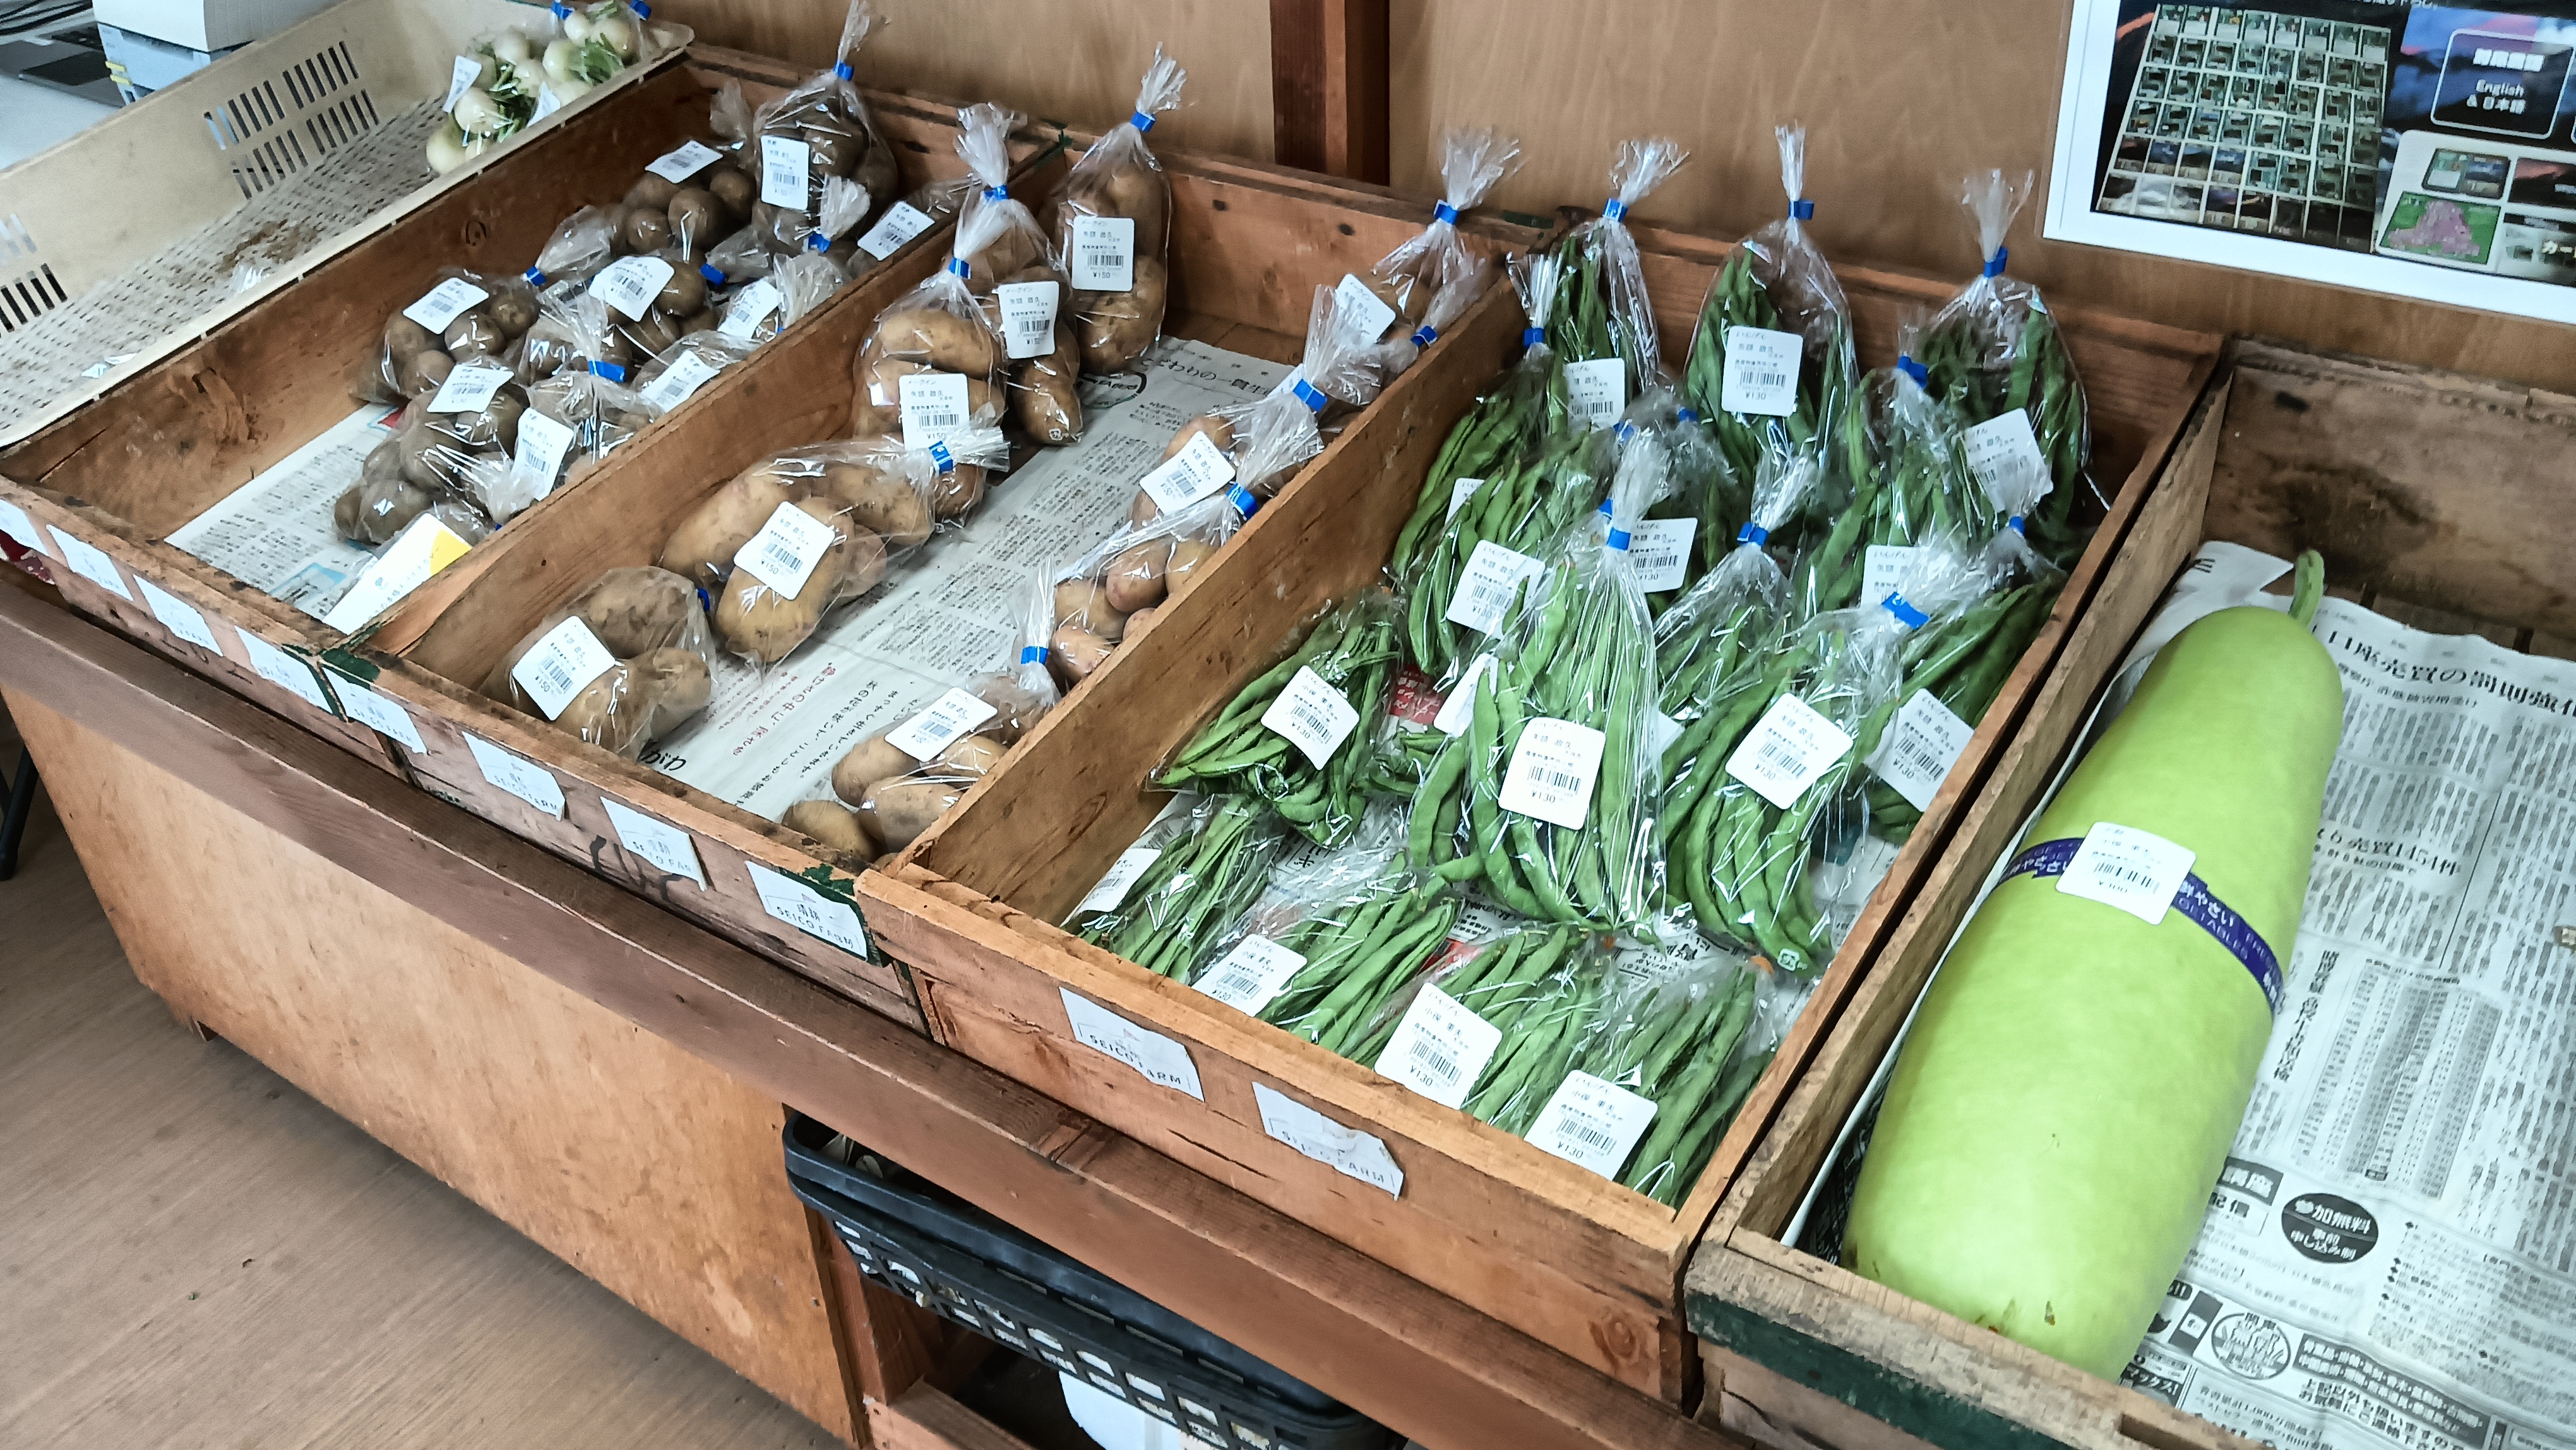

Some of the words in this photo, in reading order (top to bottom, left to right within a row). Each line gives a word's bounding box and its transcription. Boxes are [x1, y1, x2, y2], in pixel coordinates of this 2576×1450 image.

[2476, 79, 2525, 97] English
[760, 558, 779, 575] ¥150
[1291, 721, 1311, 739] ¥130
[1755, 764, 1776, 781] ¥130
[1531, 791, 1556, 804] ¥130
[777, 906, 814, 929] SEICO
[819, 925, 854, 949] FARM
[1089, 1034, 1133, 1062] SEICO
[1138, 1061, 1182, 1085] FARM
[1409, 1065, 1434, 1088] ¥130
[1556, 1141, 1585, 1159] ¥130
[2294, 1199, 2372, 1235] 参加無料
[2290, 1230, 2358, 1261] 申し込み制
